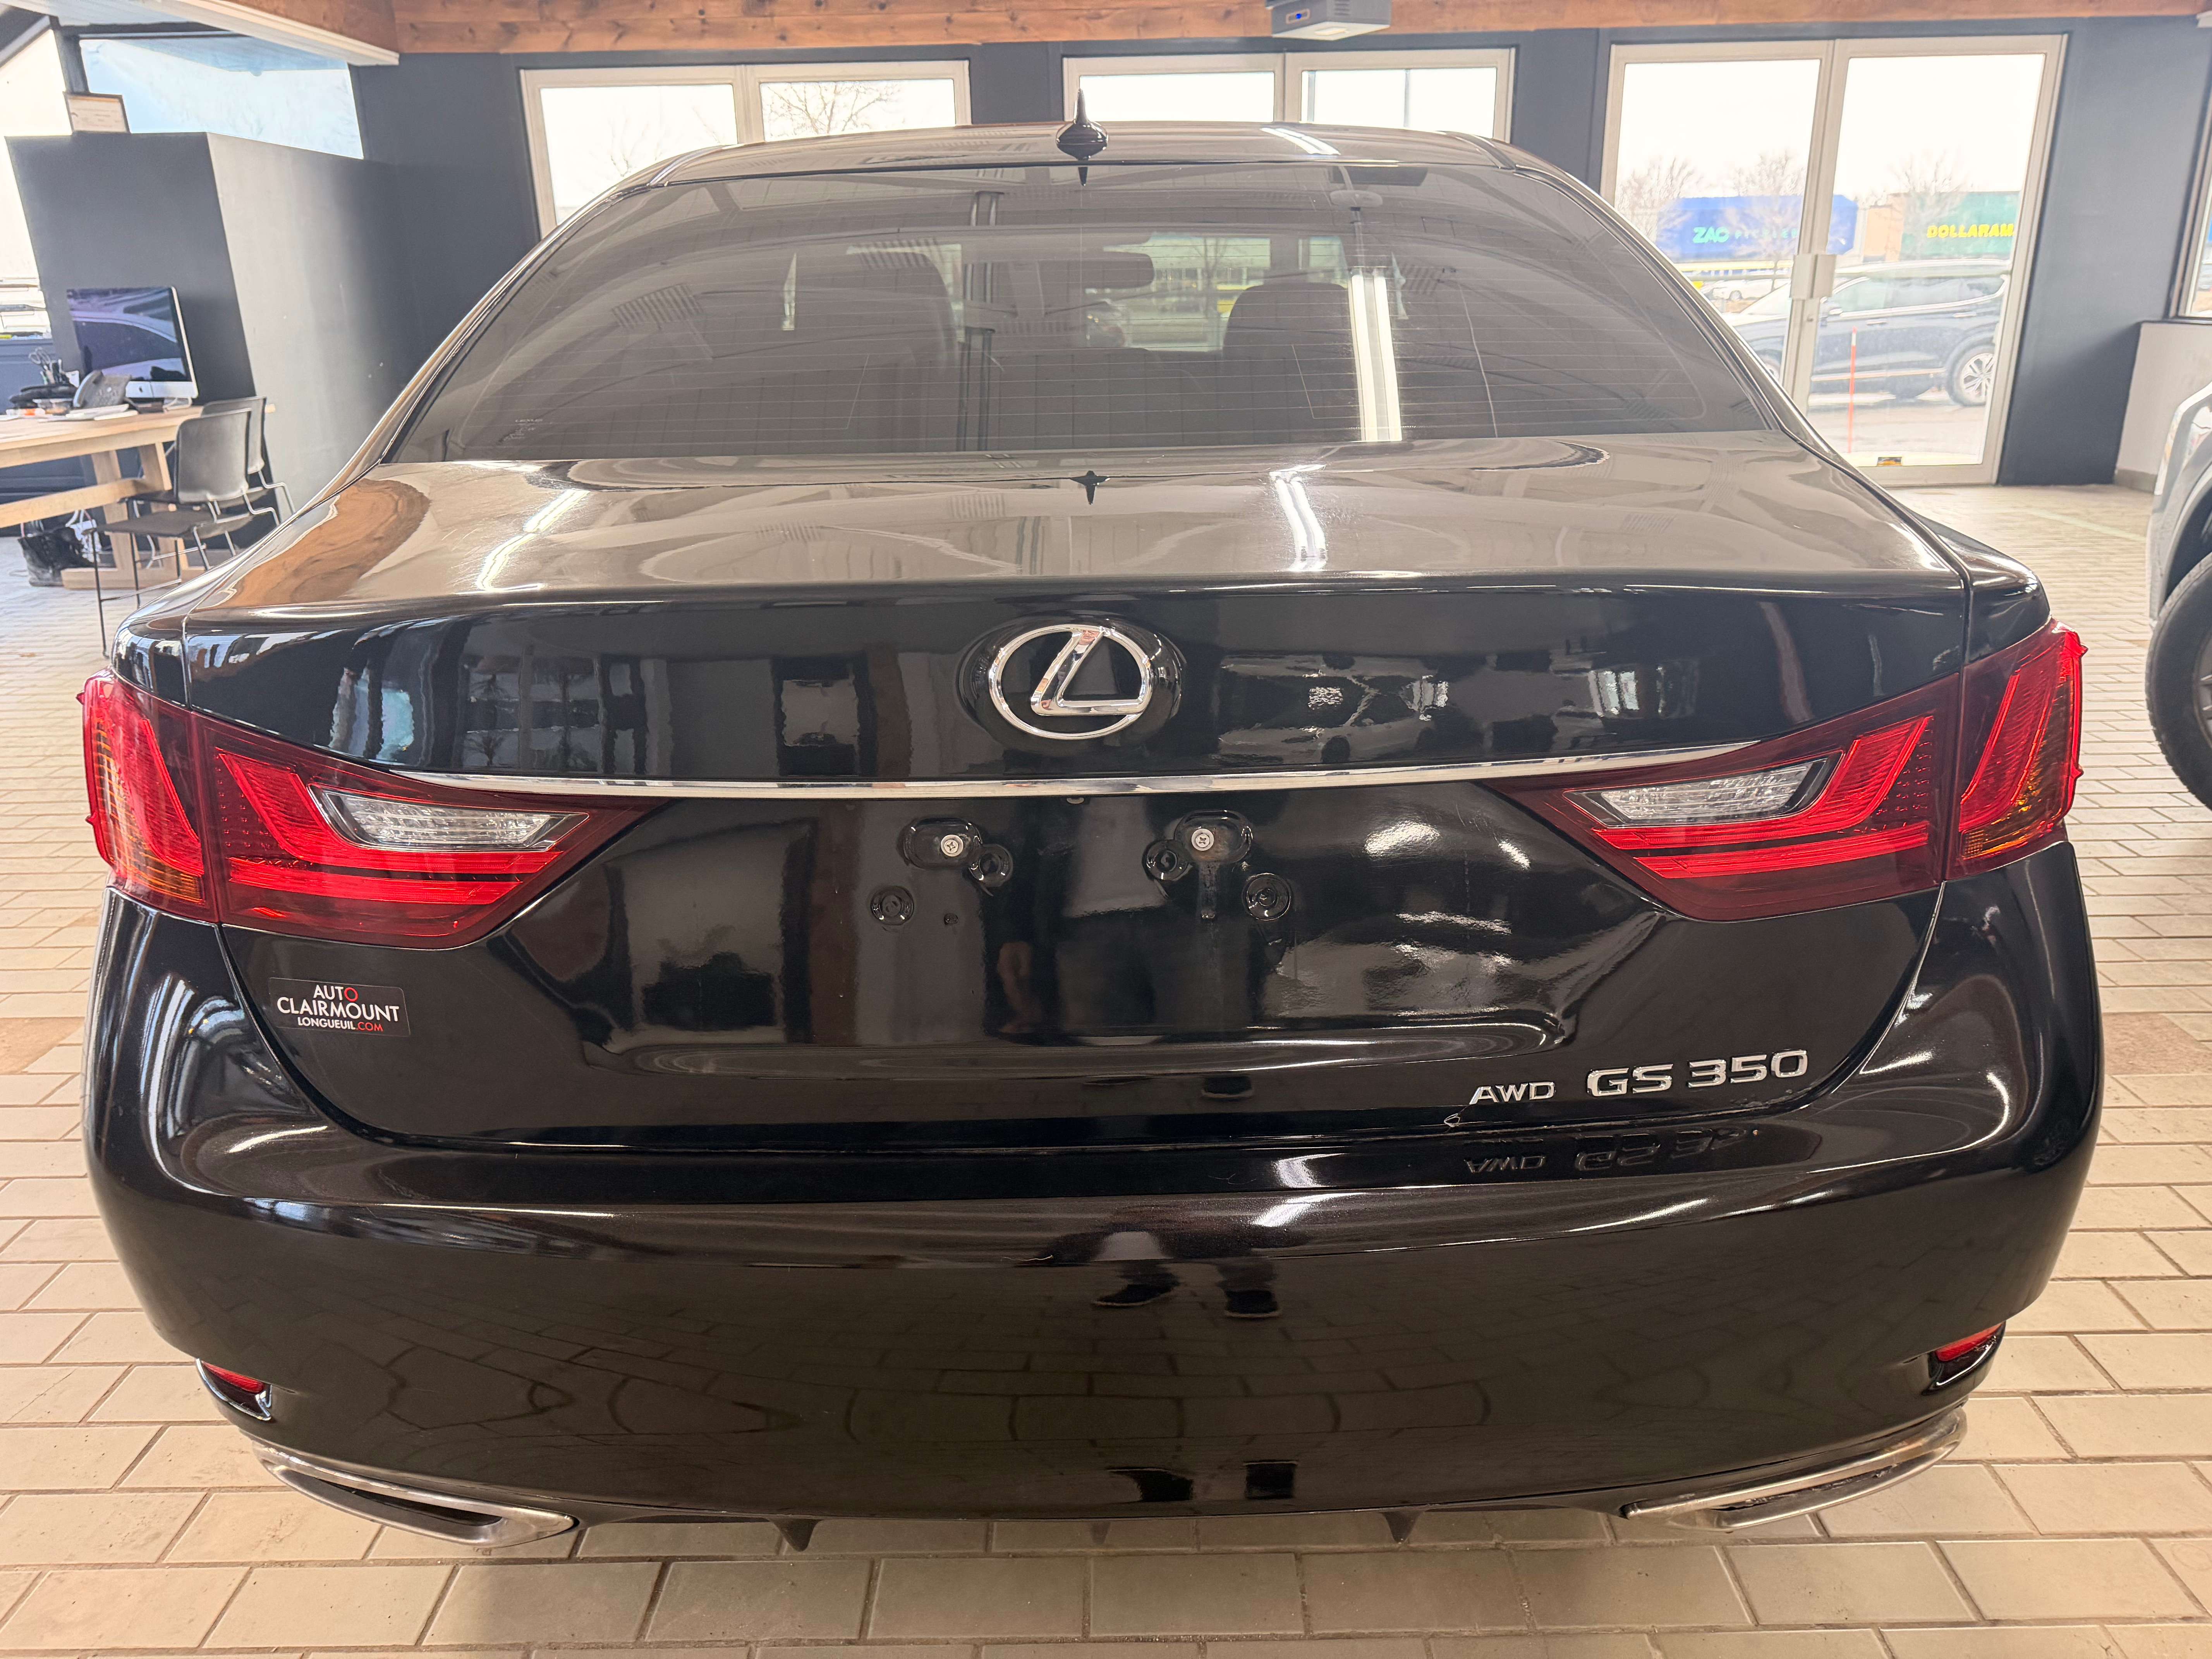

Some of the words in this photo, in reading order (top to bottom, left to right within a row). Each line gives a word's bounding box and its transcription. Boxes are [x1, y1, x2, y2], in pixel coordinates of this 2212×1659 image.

[1927, 223, 2014, 238] DOLLARAM
[313, 984, 359, 1002] AUTO
[277, 997, 399, 1022] CLAIRMOUNT
[297, 1017, 383, 1032] LONGUEUIL.COM
[1469, 1081, 1556, 1104] AWD
[1587, 1063, 1673, 1097] GS
[1688, 1049, 1808, 1088] 350
